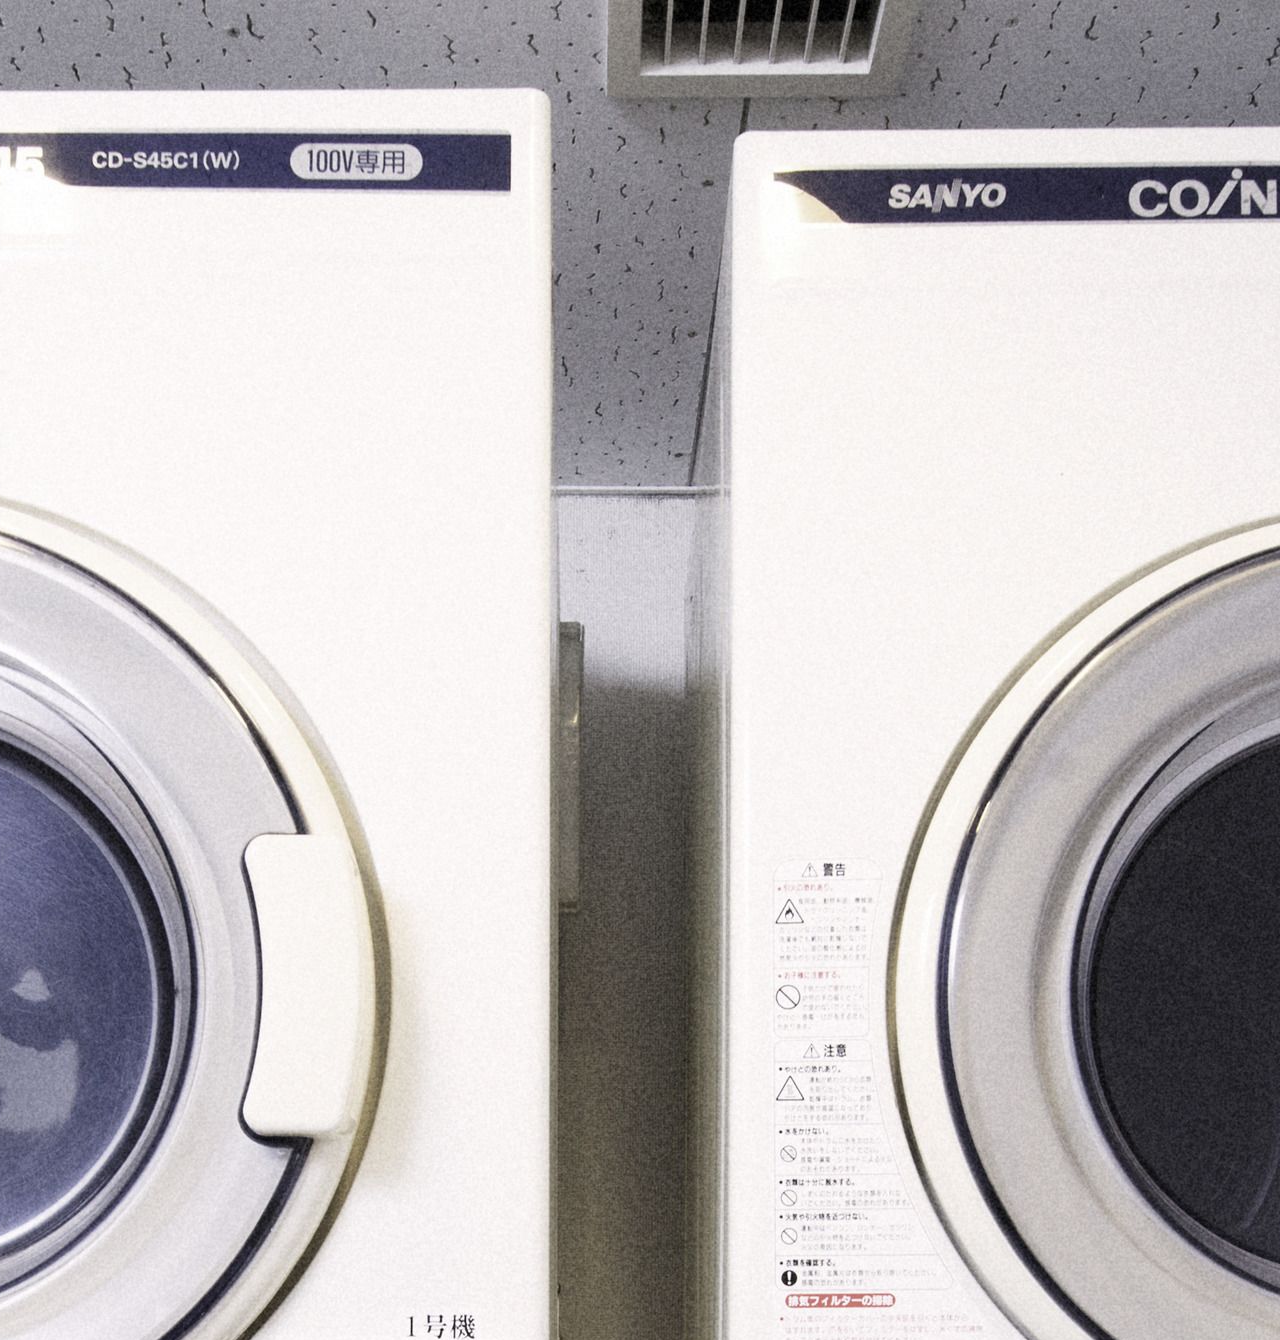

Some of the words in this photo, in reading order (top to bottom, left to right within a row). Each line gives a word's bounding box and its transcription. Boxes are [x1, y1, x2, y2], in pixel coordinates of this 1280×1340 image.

[91, 149, 240, 171] CD-S45C1(W)
[306, 148, 406, 175] 100V専用
[888, 178, 1007, 213] SANYO
[408, 1314, 476, 1340] 1号機
